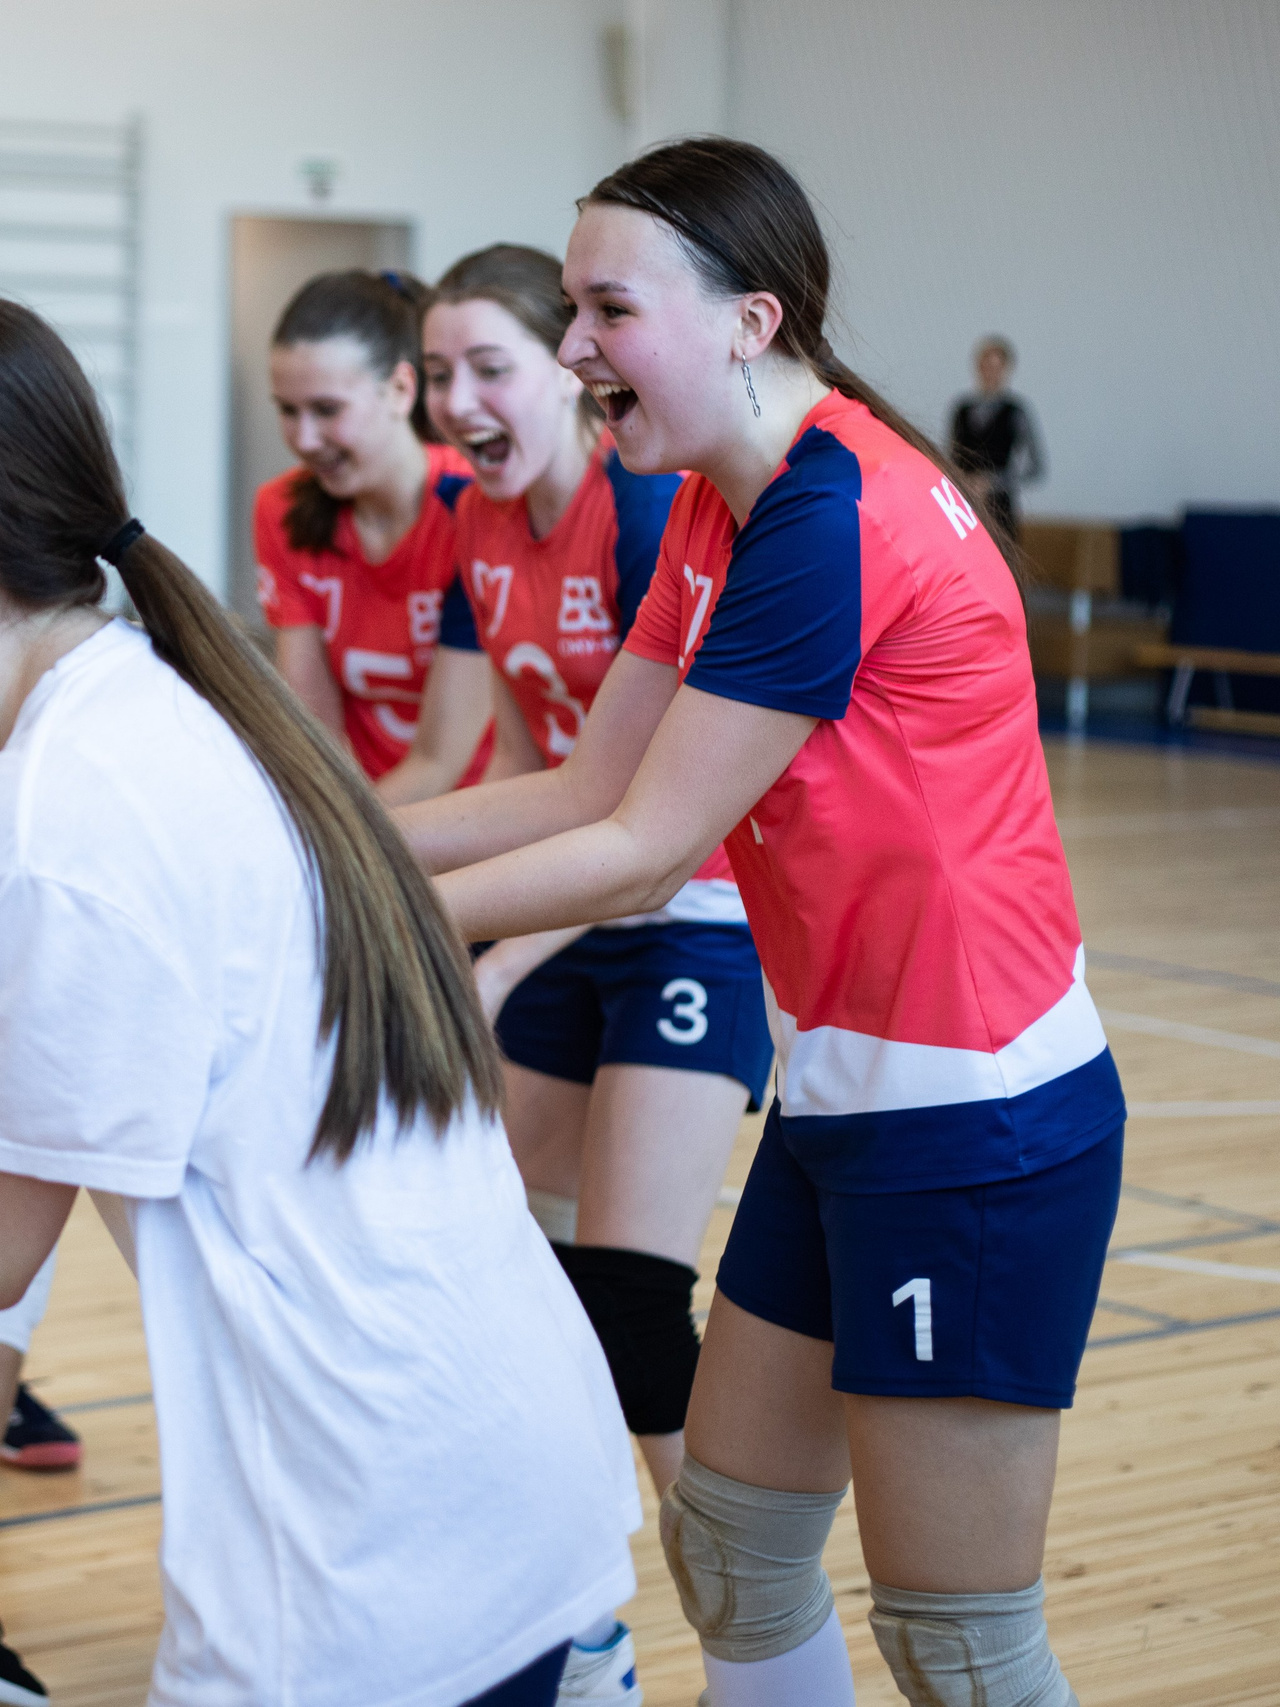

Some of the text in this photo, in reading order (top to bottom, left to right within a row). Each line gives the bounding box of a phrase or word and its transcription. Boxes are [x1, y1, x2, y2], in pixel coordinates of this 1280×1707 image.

[344, 647, 420, 742] 5
[503, 641, 586, 756] 3
[656, 977, 709, 1046] 3
[892, 1277, 934, 1362] 1
